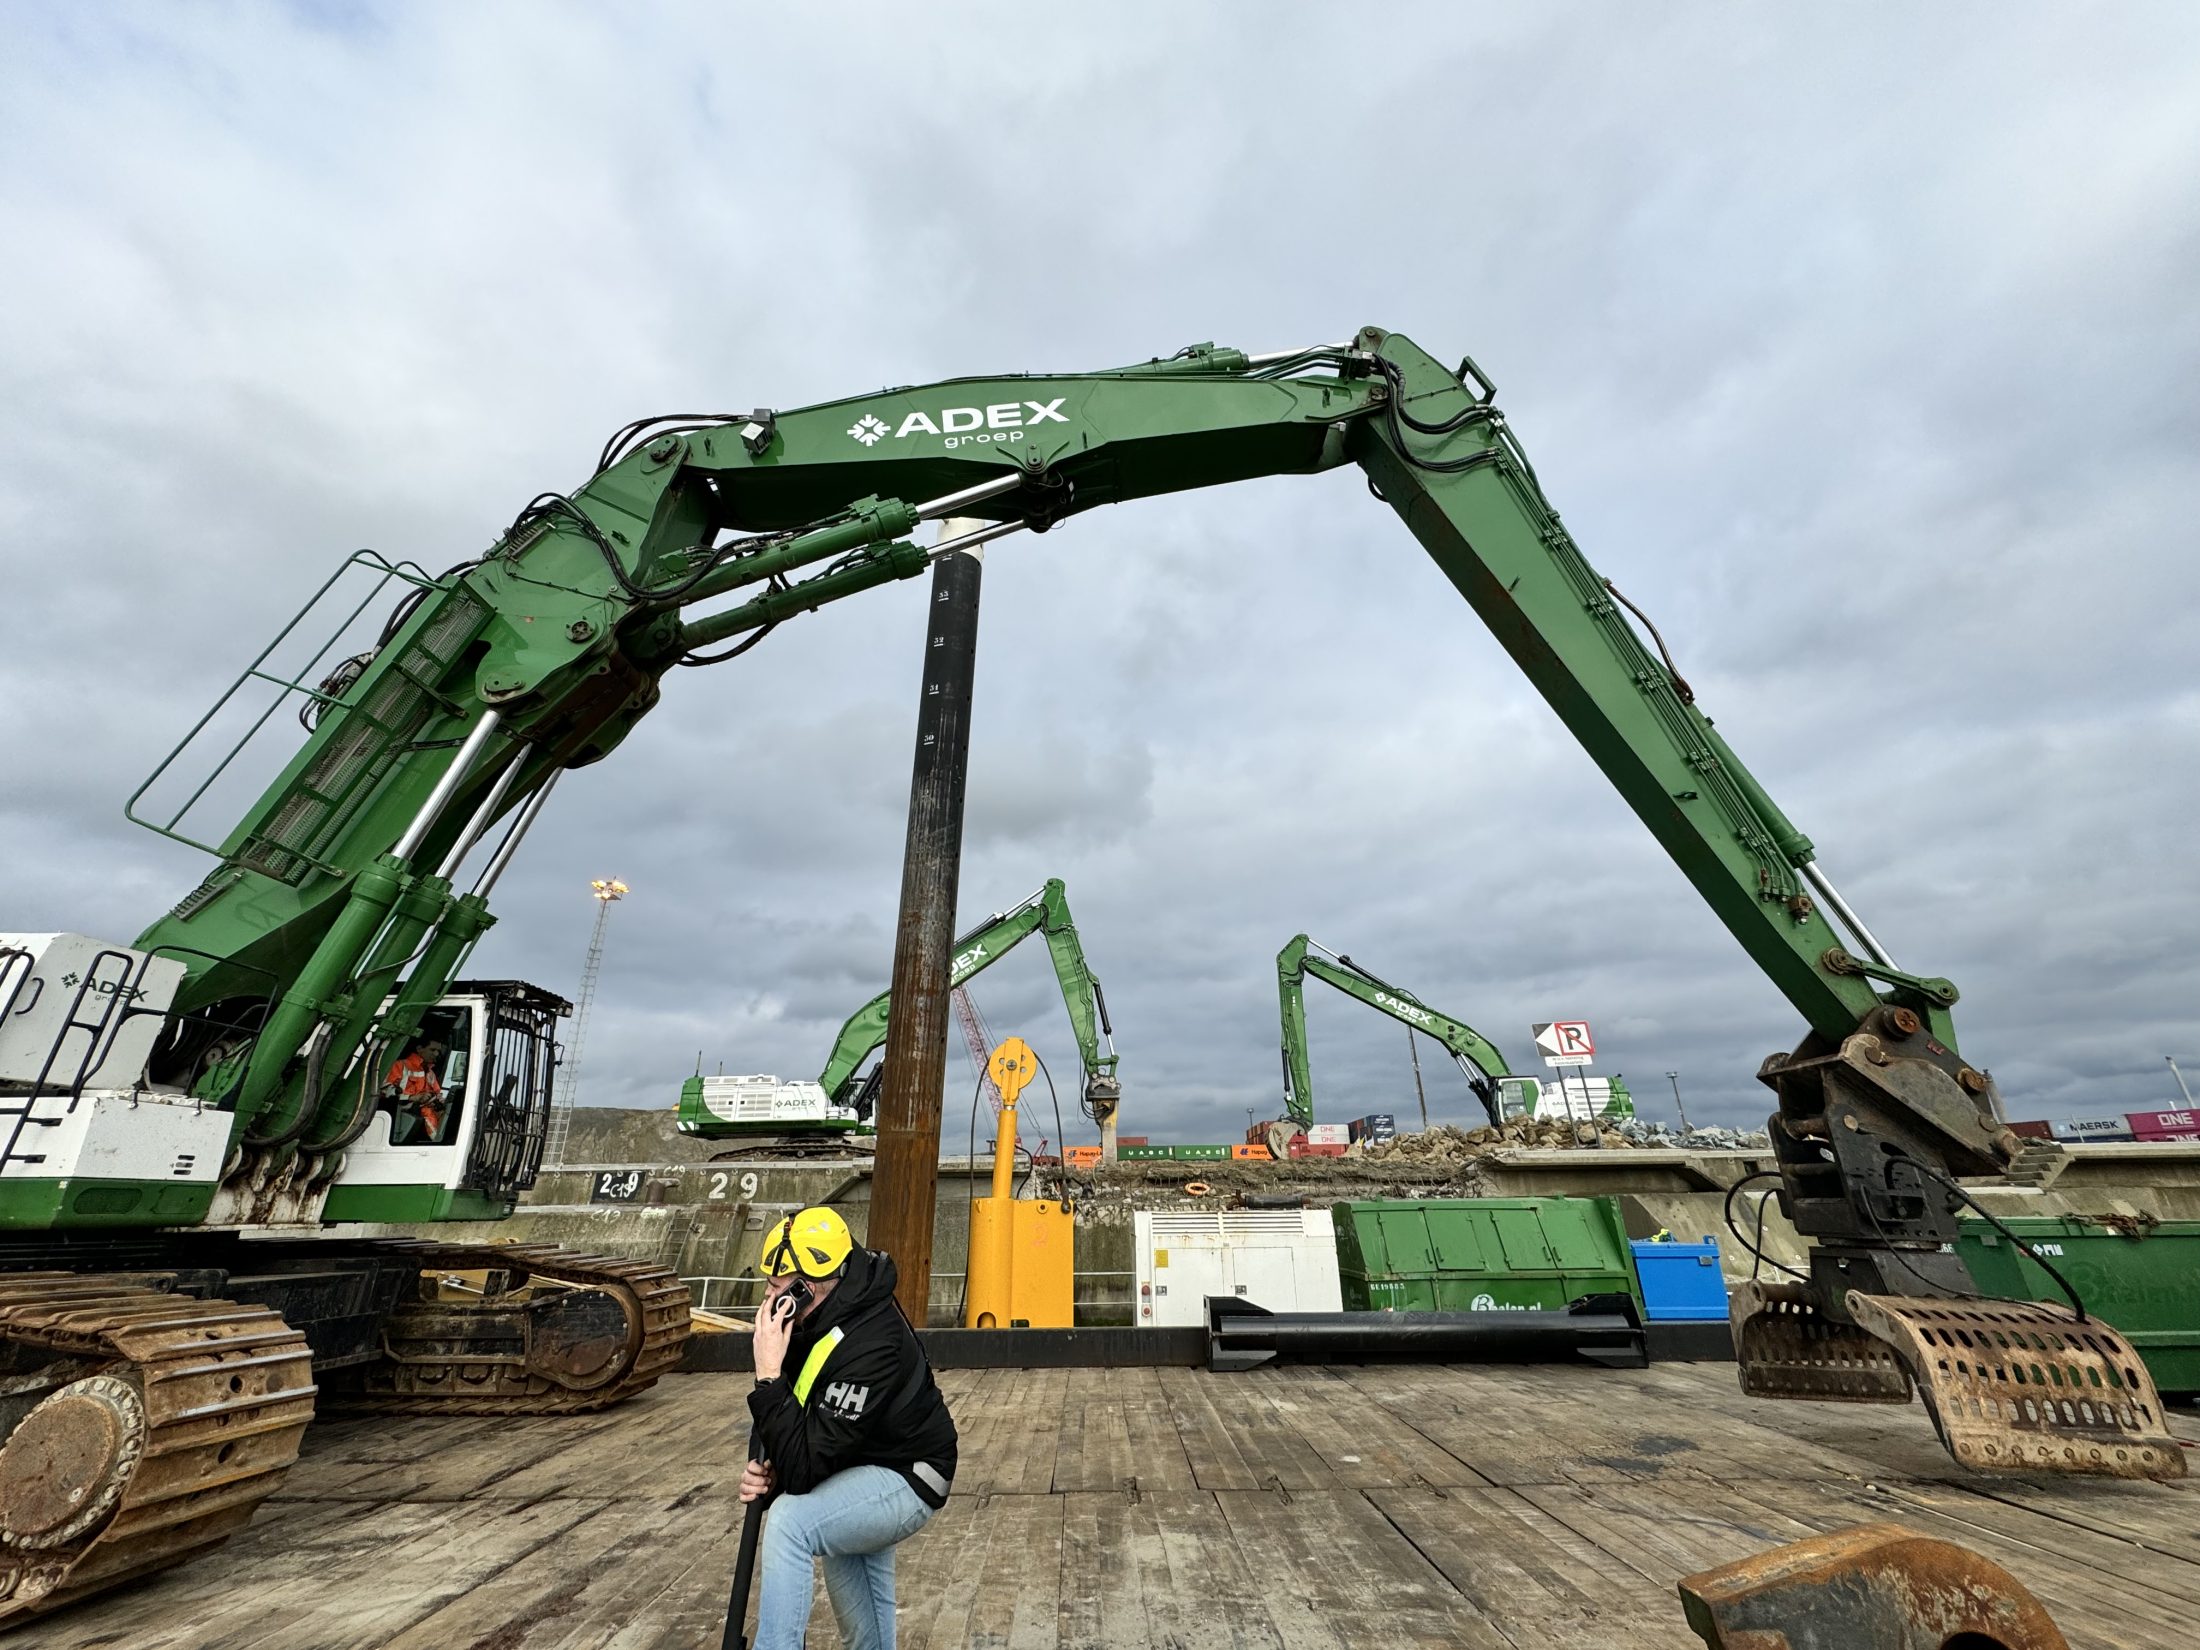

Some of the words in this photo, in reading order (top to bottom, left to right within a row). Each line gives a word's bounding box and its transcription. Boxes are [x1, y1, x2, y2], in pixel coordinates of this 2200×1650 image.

[894, 398, 1070, 438] ADEX
[944, 429, 1024, 449] groep
[951, 943, 988, 975] DEX
[1385, 997, 1433, 1026] ADEX
[784, 1099, 816, 1107] ADEX
[2069, 1120, 2119, 1131] MAERSK
[2157, 1112, 2195, 1126] ONE
[824, 1381, 870, 1413] HH
